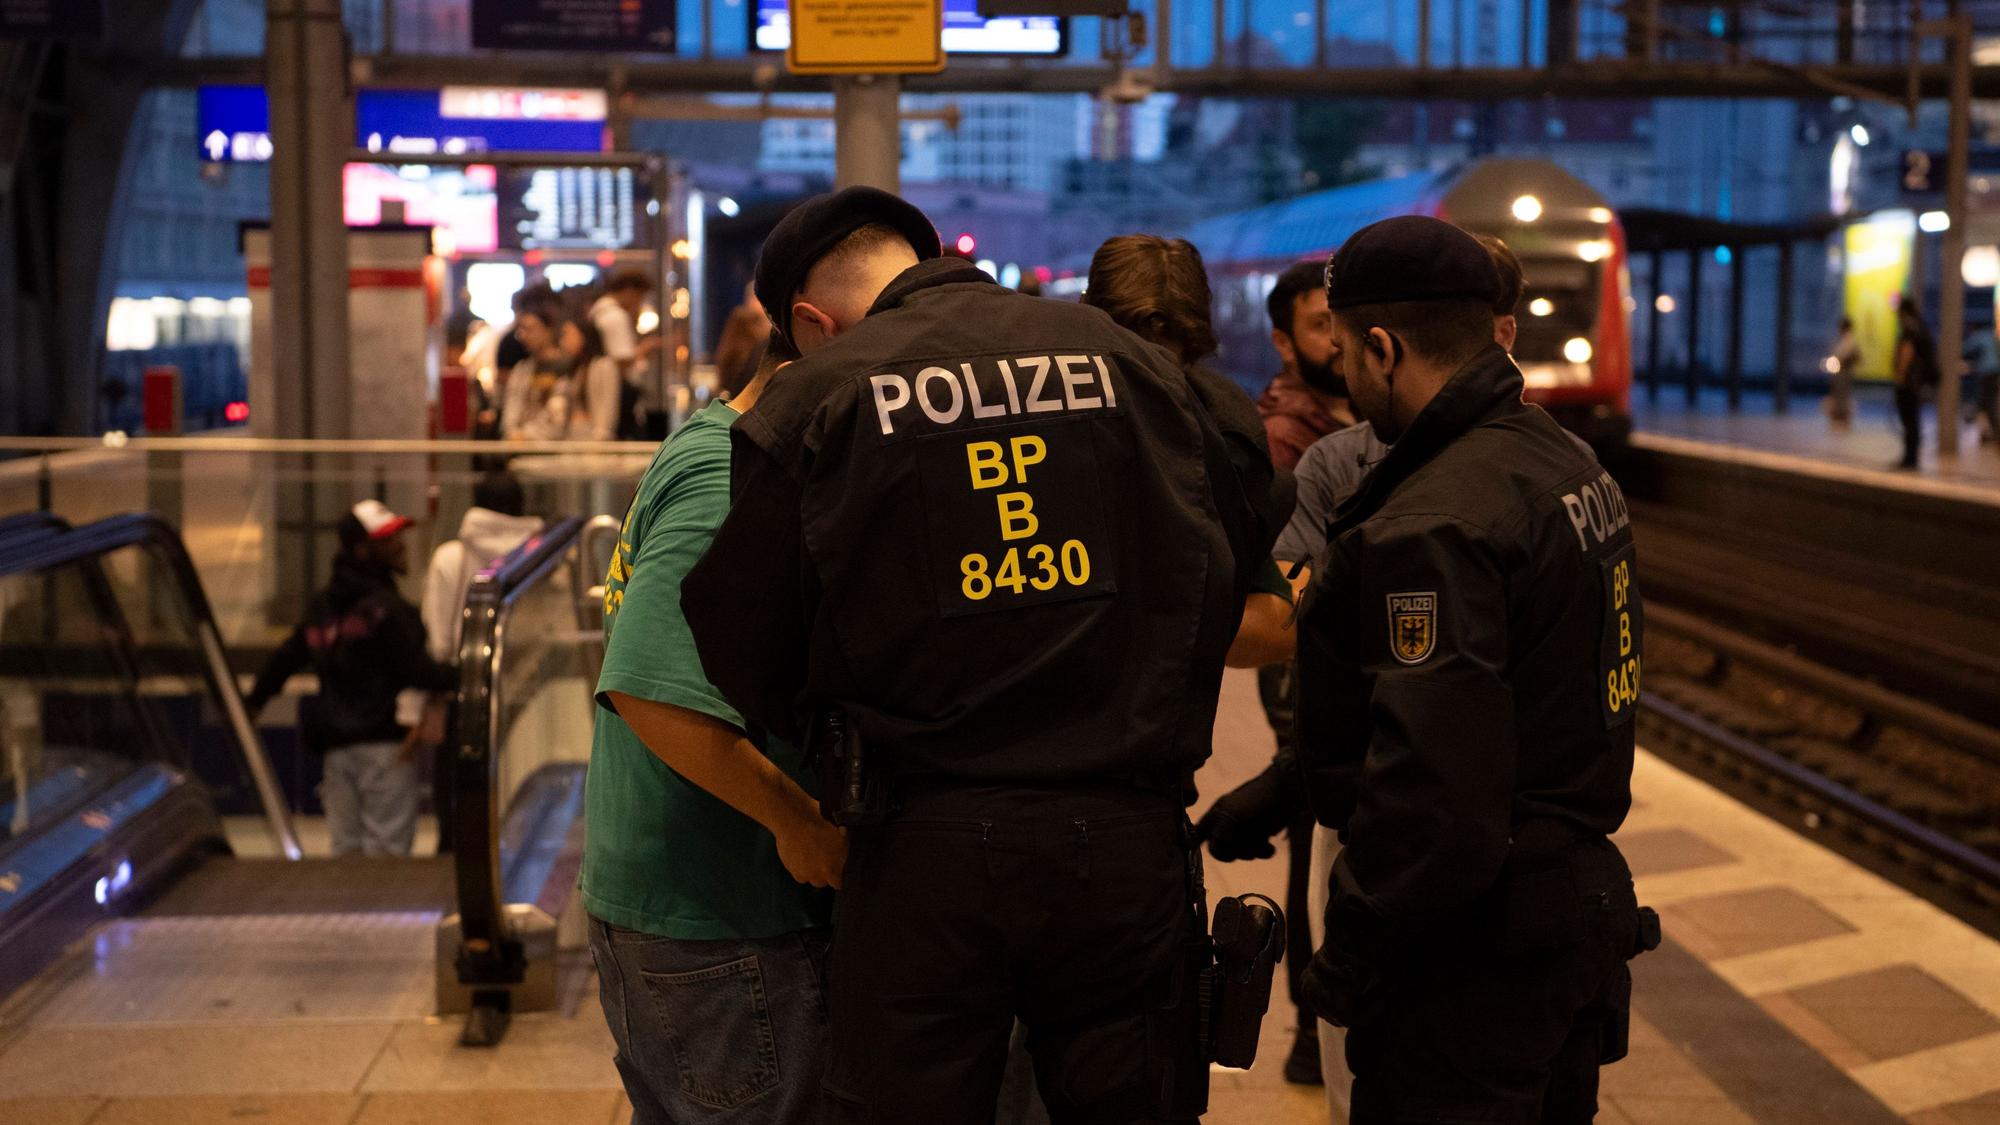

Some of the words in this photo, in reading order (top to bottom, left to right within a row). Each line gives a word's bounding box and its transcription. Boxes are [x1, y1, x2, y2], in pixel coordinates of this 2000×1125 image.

[1904, 150, 1931, 190] 2
[869, 355, 1116, 435] POLIZEI
[966, 435, 1047, 489] BP
[996, 491, 1039, 541] B
[960, 539, 1090, 600] 8430
[1614, 560, 1630, 610] BP
[1392, 597, 1433, 612] POLIZEI
[1619, 611, 1632, 657] B
